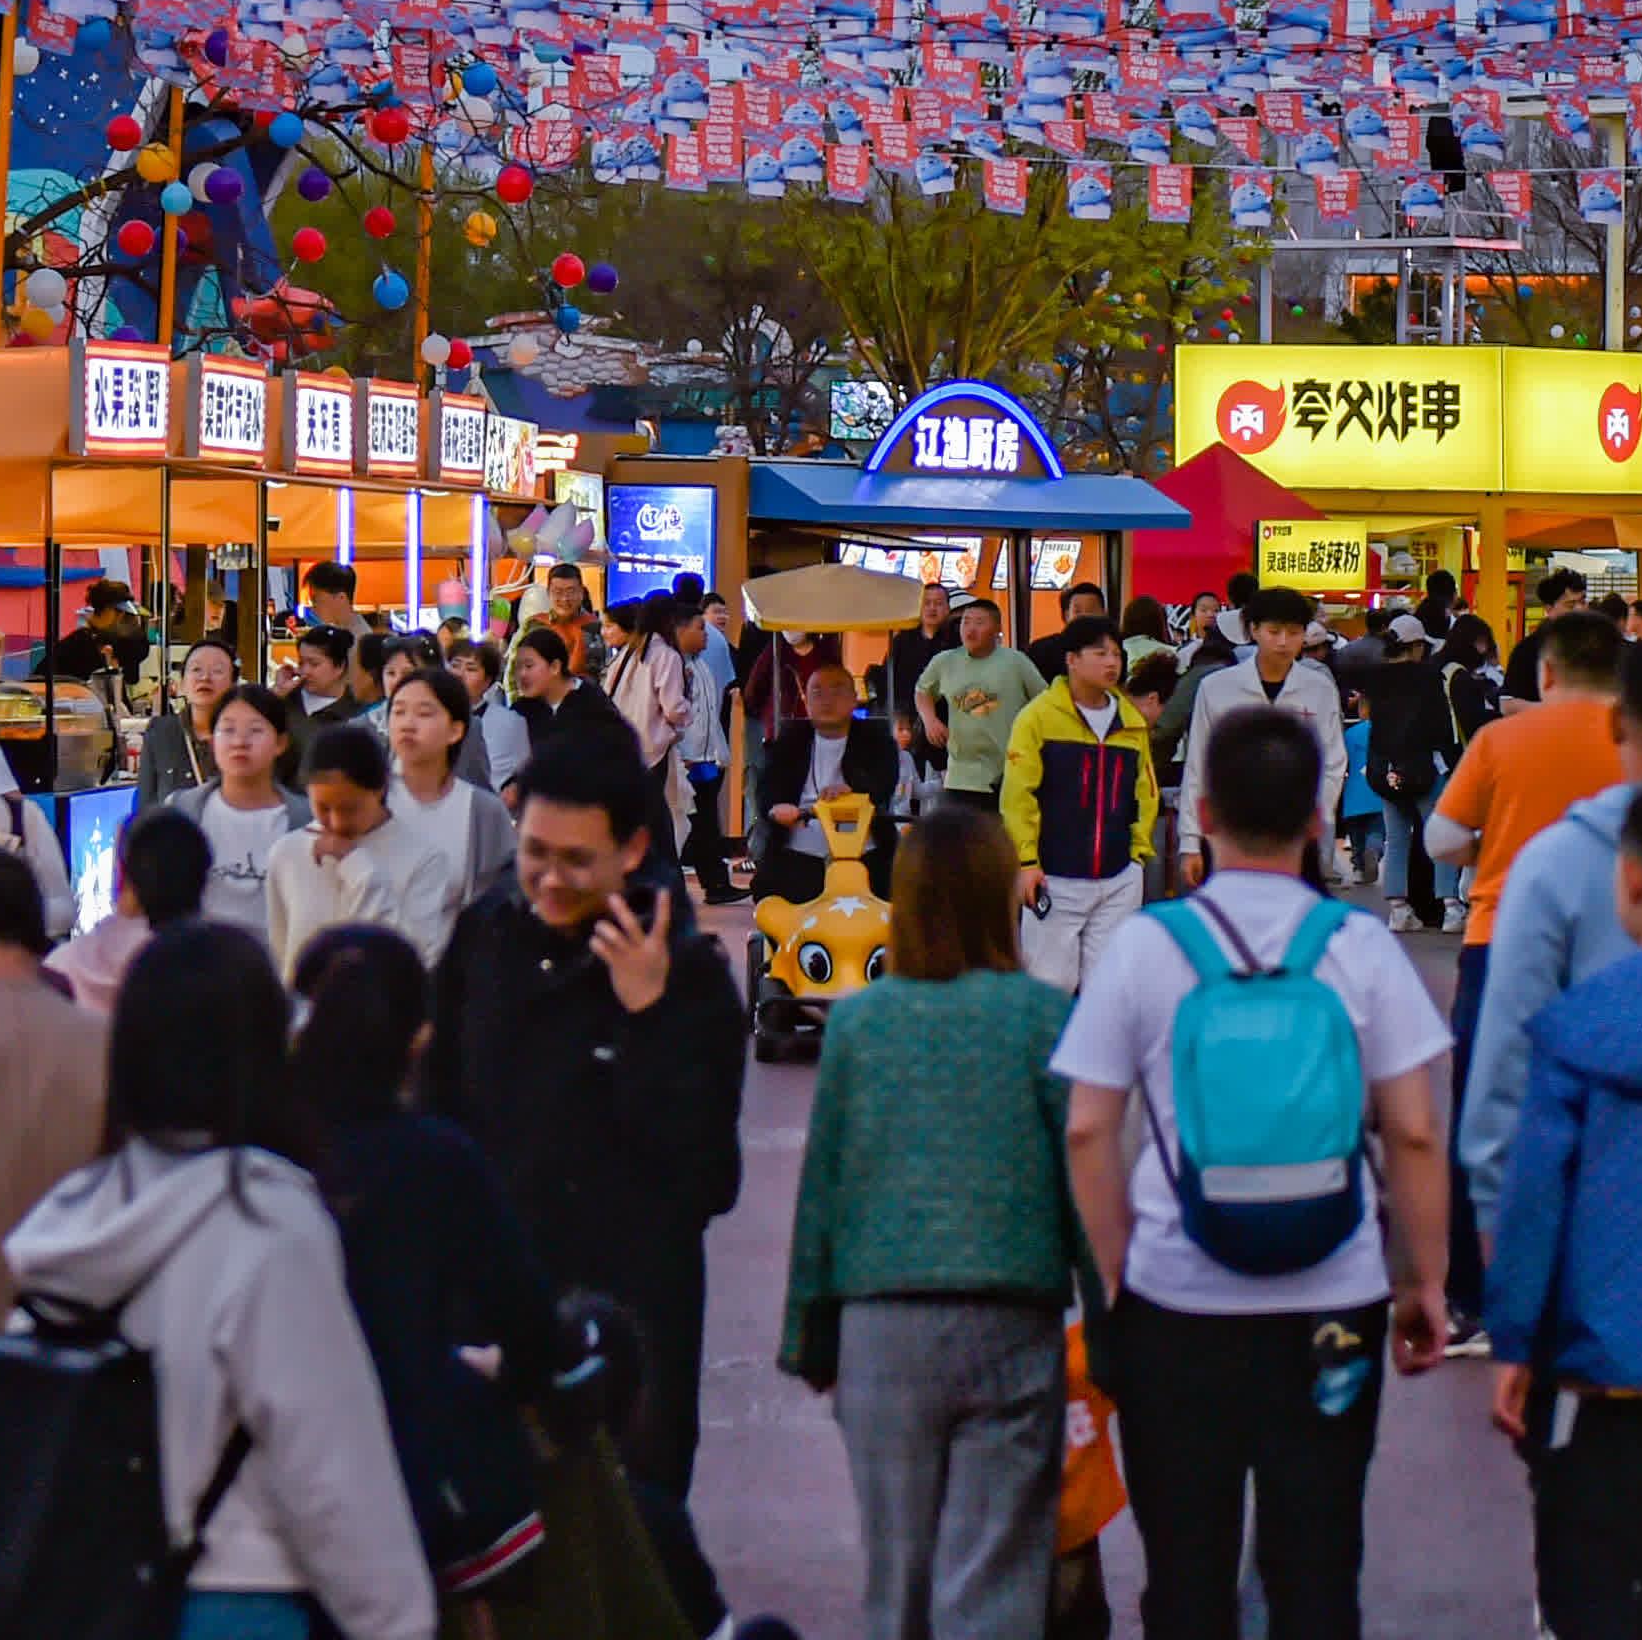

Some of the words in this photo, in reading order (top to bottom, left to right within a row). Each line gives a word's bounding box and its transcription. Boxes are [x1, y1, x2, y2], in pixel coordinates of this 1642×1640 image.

[1292, 379, 1461, 442] 夸父炸串
[915, 415, 1019, 472] 辽渔厨房
